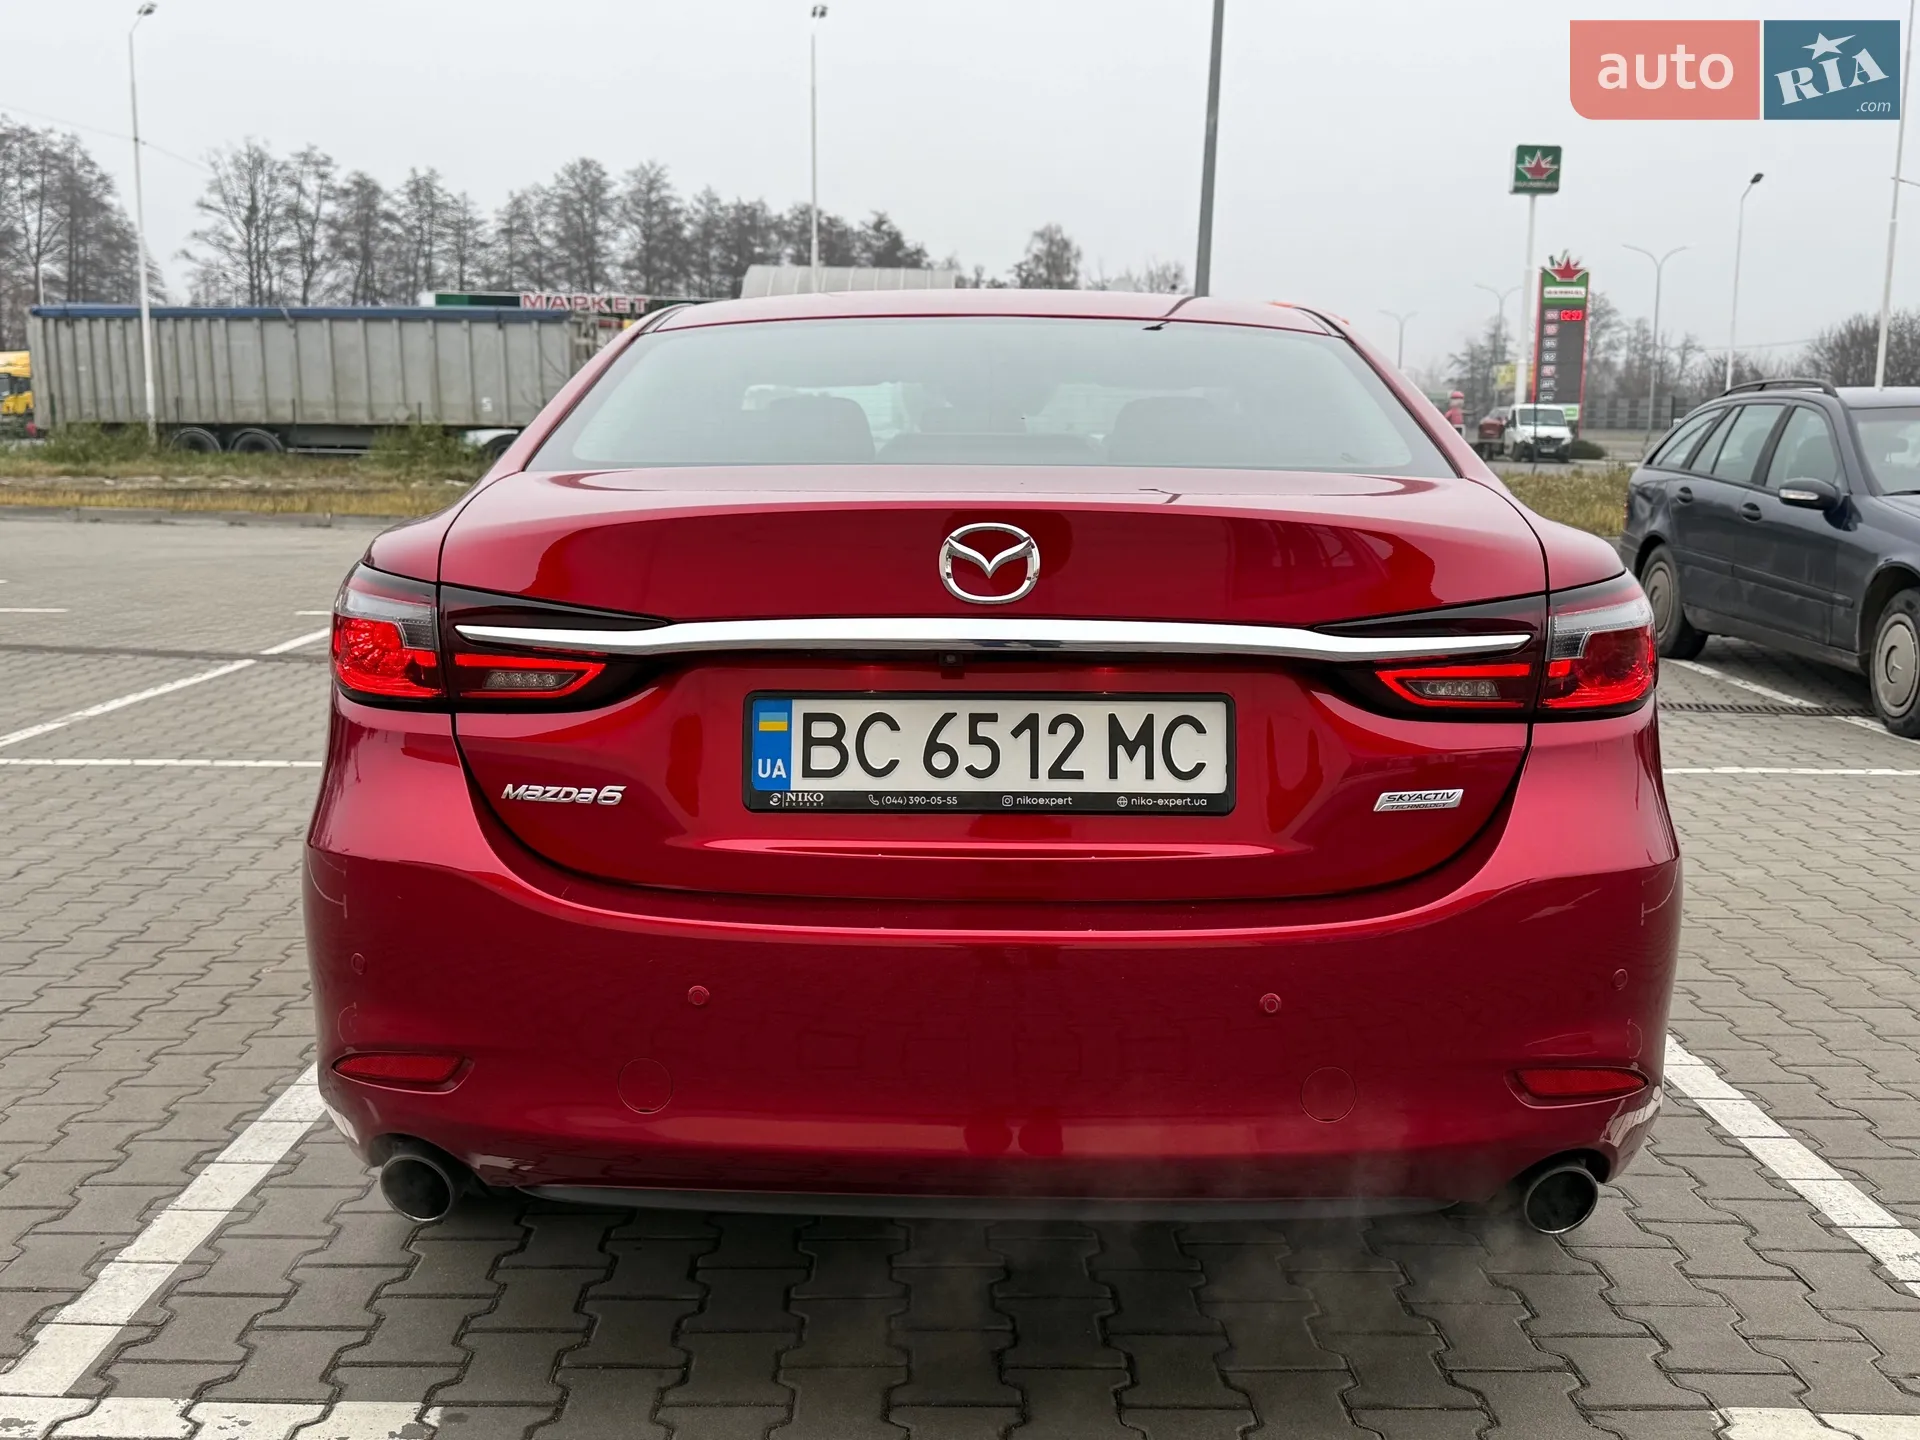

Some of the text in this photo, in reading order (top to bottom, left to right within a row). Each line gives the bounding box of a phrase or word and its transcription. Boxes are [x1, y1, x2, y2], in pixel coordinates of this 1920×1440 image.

[520, 292, 649, 314] МАРКЕТ
[922, 711, 1085, 780] 6512
[757, 758, 787, 779] UA
[785, 792, 824, 802] NIKO
[881, 795, 958, 805] (044) 390-05-55
[1016, 795, 1073, 807] nikoexpert
[1131, 796, 1208, 808] niko-expert.ua
[1386, 791, 1456, 802] SKYACTIV
